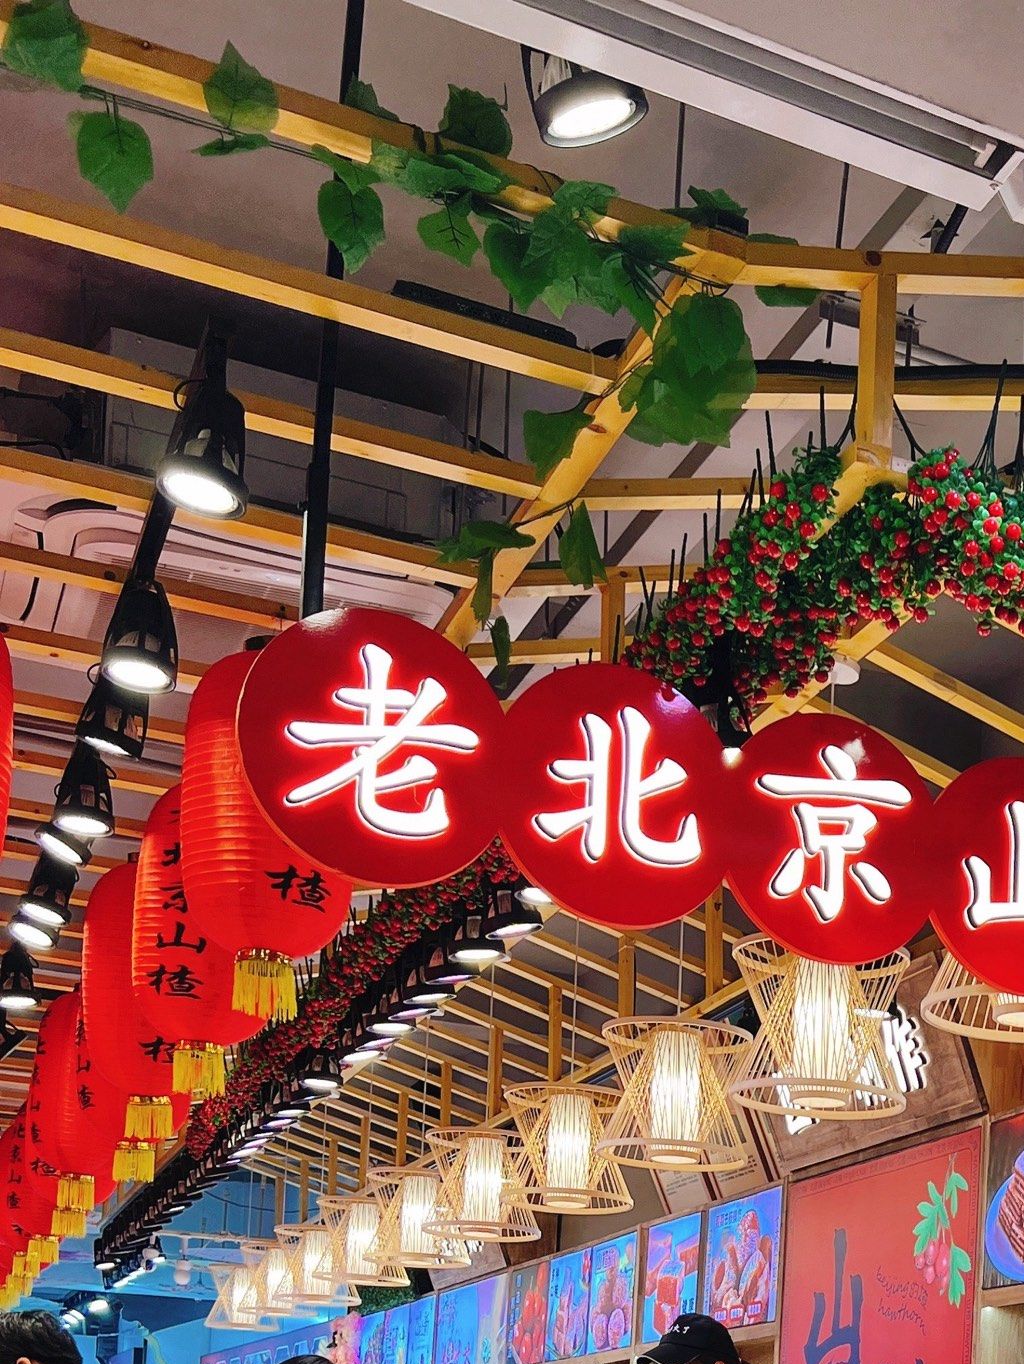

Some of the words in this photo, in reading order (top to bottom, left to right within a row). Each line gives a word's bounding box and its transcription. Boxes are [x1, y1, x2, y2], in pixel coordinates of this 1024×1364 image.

[147, 809, 206, 1000] 京山楂
[265, 864, 333, 914] 楂
